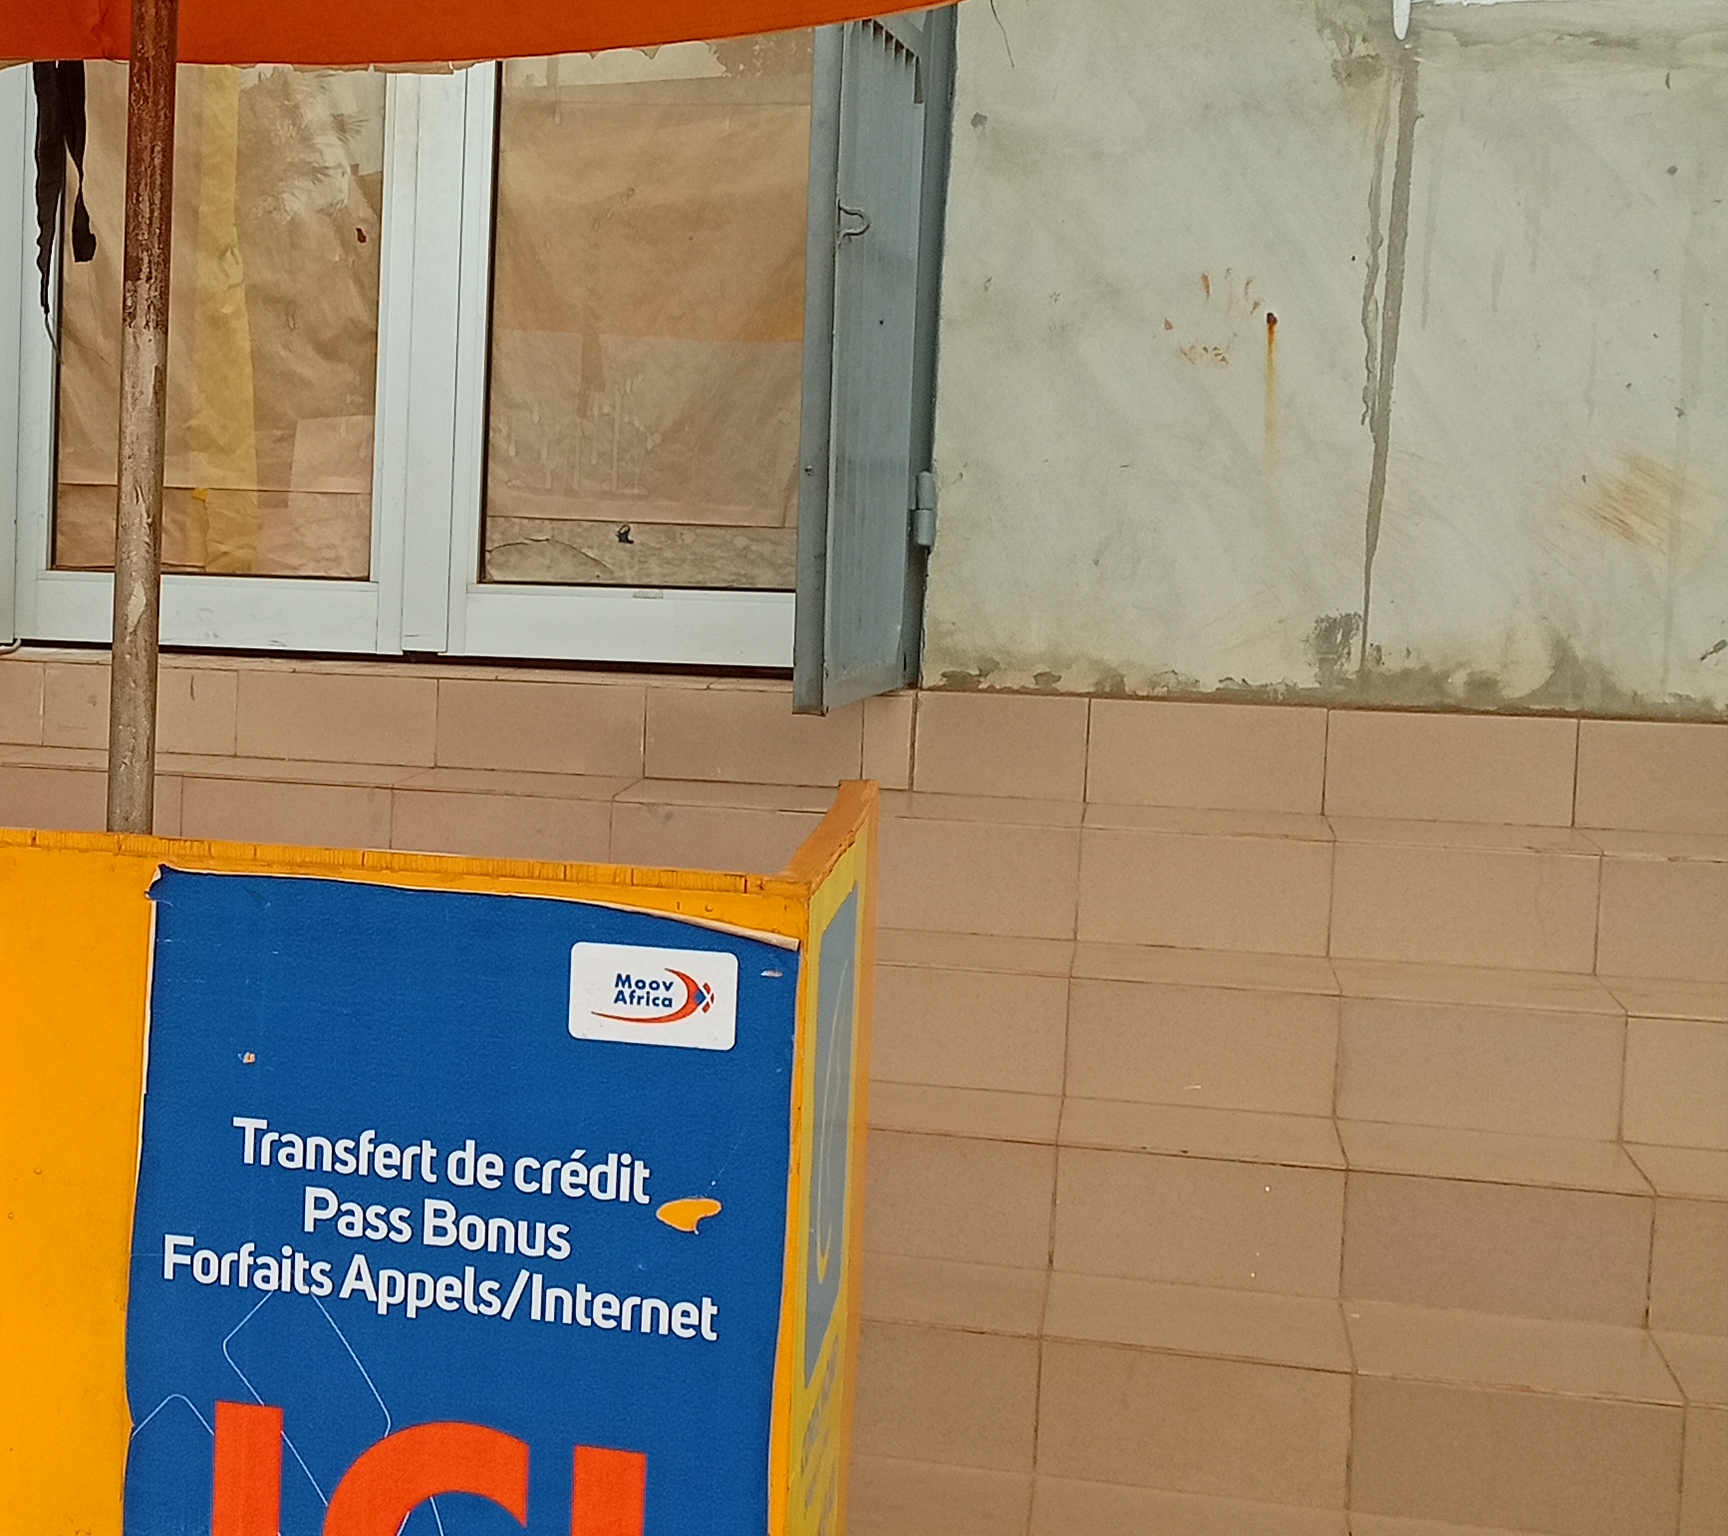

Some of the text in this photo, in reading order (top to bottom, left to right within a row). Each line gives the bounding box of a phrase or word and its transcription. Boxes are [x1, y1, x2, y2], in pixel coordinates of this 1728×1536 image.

[613, 989, 674, 1008] Africa
[614, 972, 674, 993] Moov
[231, 1115, 651, 1205] Transfert de crédit
[303, 1185, 572, 1261] Pass Bonus
[162, 1233, 719, 1342] Forfaits Appels/Internet
